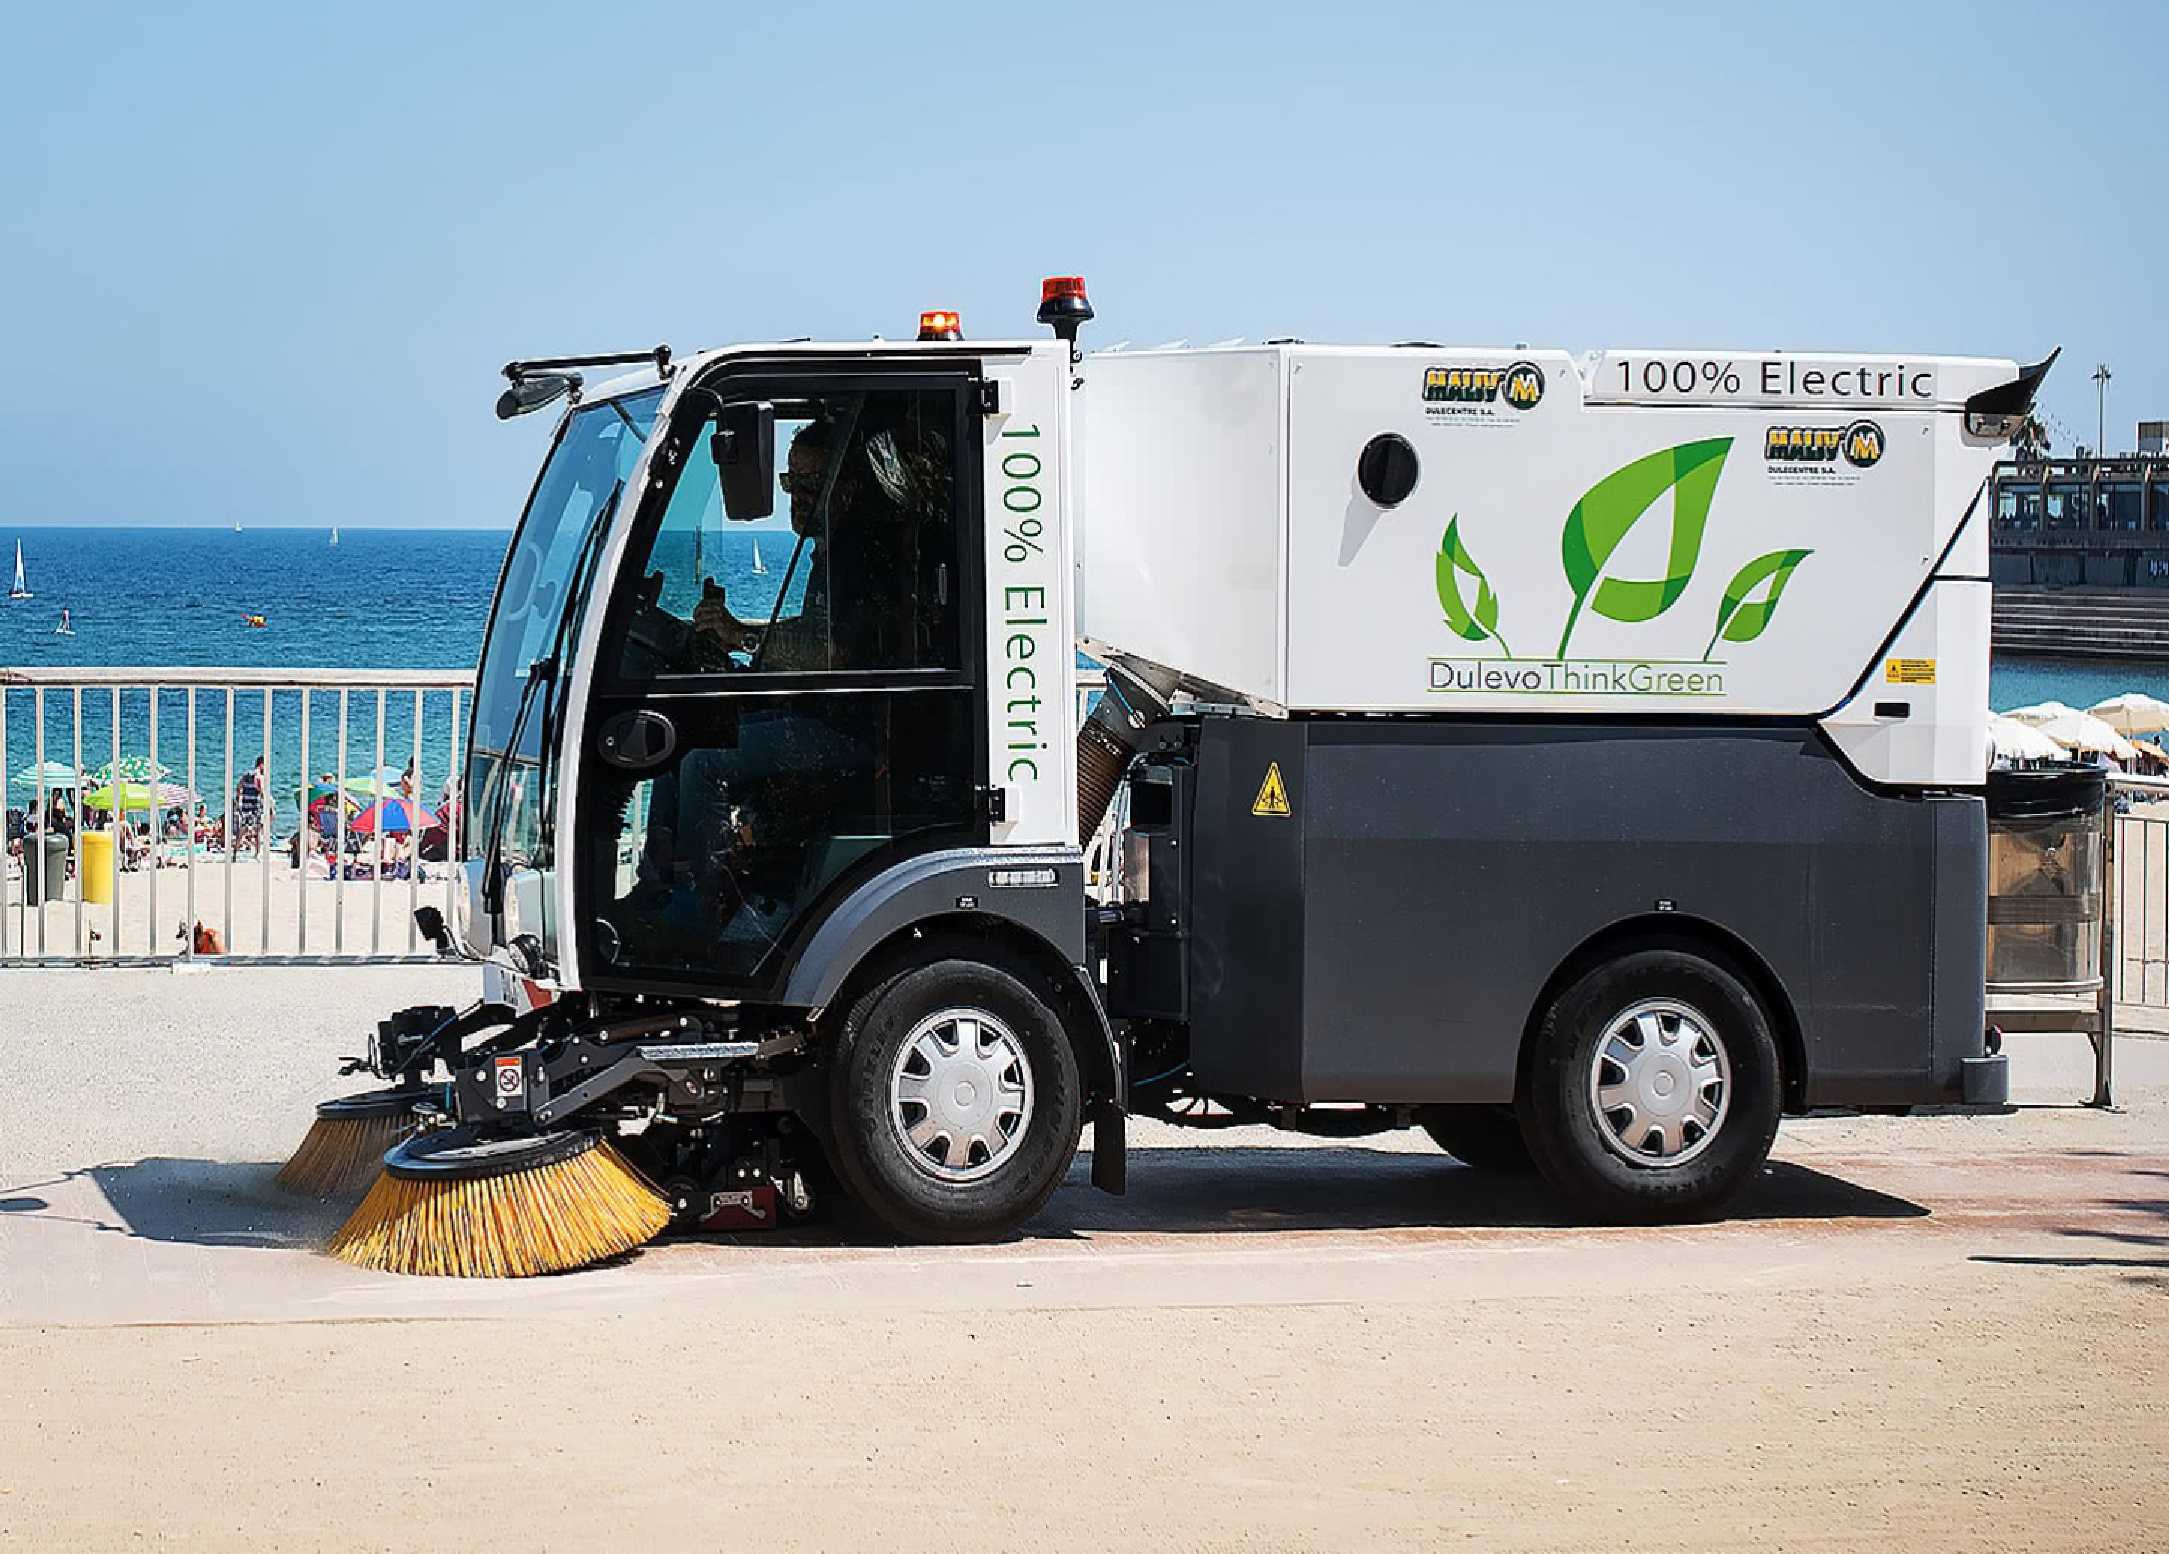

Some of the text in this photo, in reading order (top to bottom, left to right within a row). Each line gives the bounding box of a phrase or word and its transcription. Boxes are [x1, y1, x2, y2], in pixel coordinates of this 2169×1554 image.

[1616, 360, 1933, 398] 100% Electric
[1001, 424, 1048, 782] 100% Electric
[1430, 661, 1724, 692] DulevoThinkGreen
